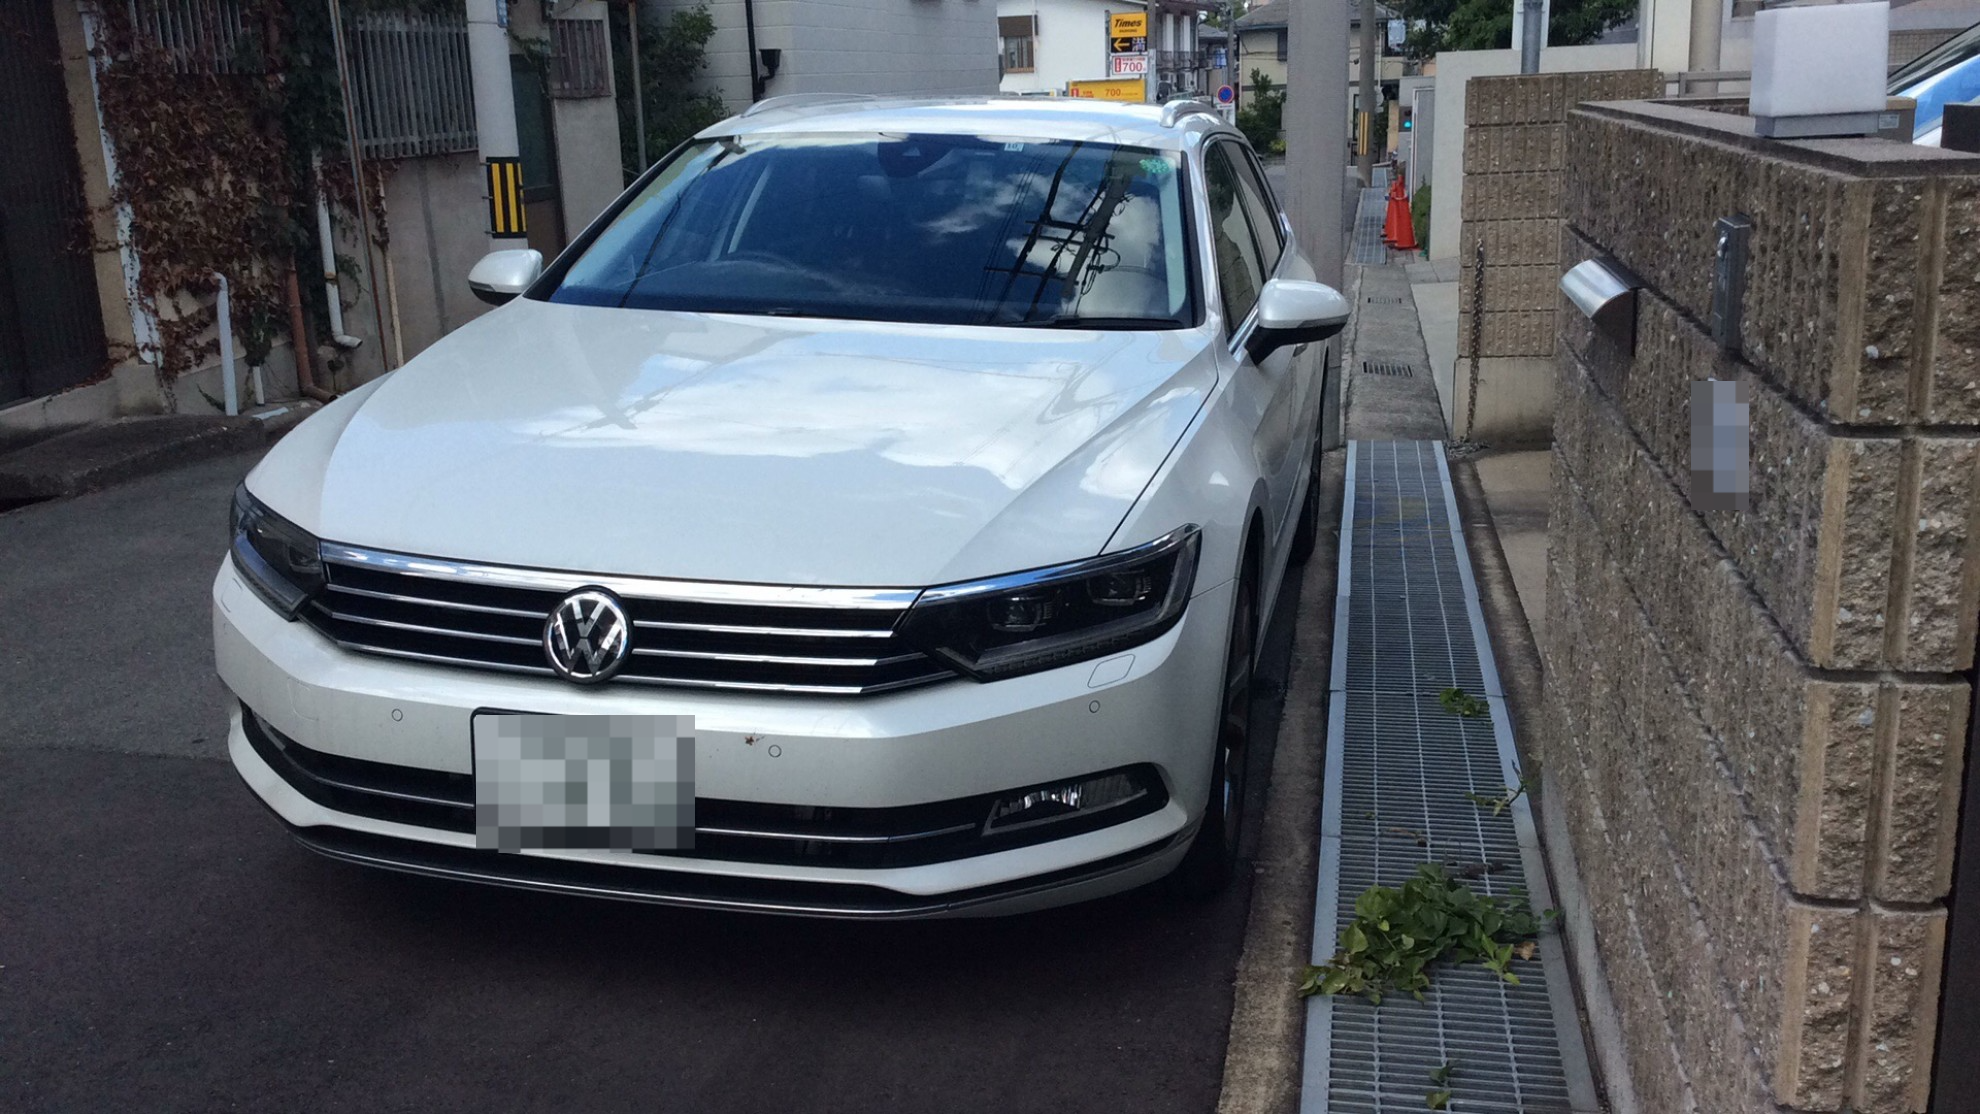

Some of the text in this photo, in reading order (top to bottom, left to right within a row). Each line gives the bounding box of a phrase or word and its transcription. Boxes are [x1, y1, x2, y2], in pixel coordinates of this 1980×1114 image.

[1115, 18, 1142, 28] Times
[1123, 62, 1143, 72] 700
[1105, 88, 1121, 97] 700
